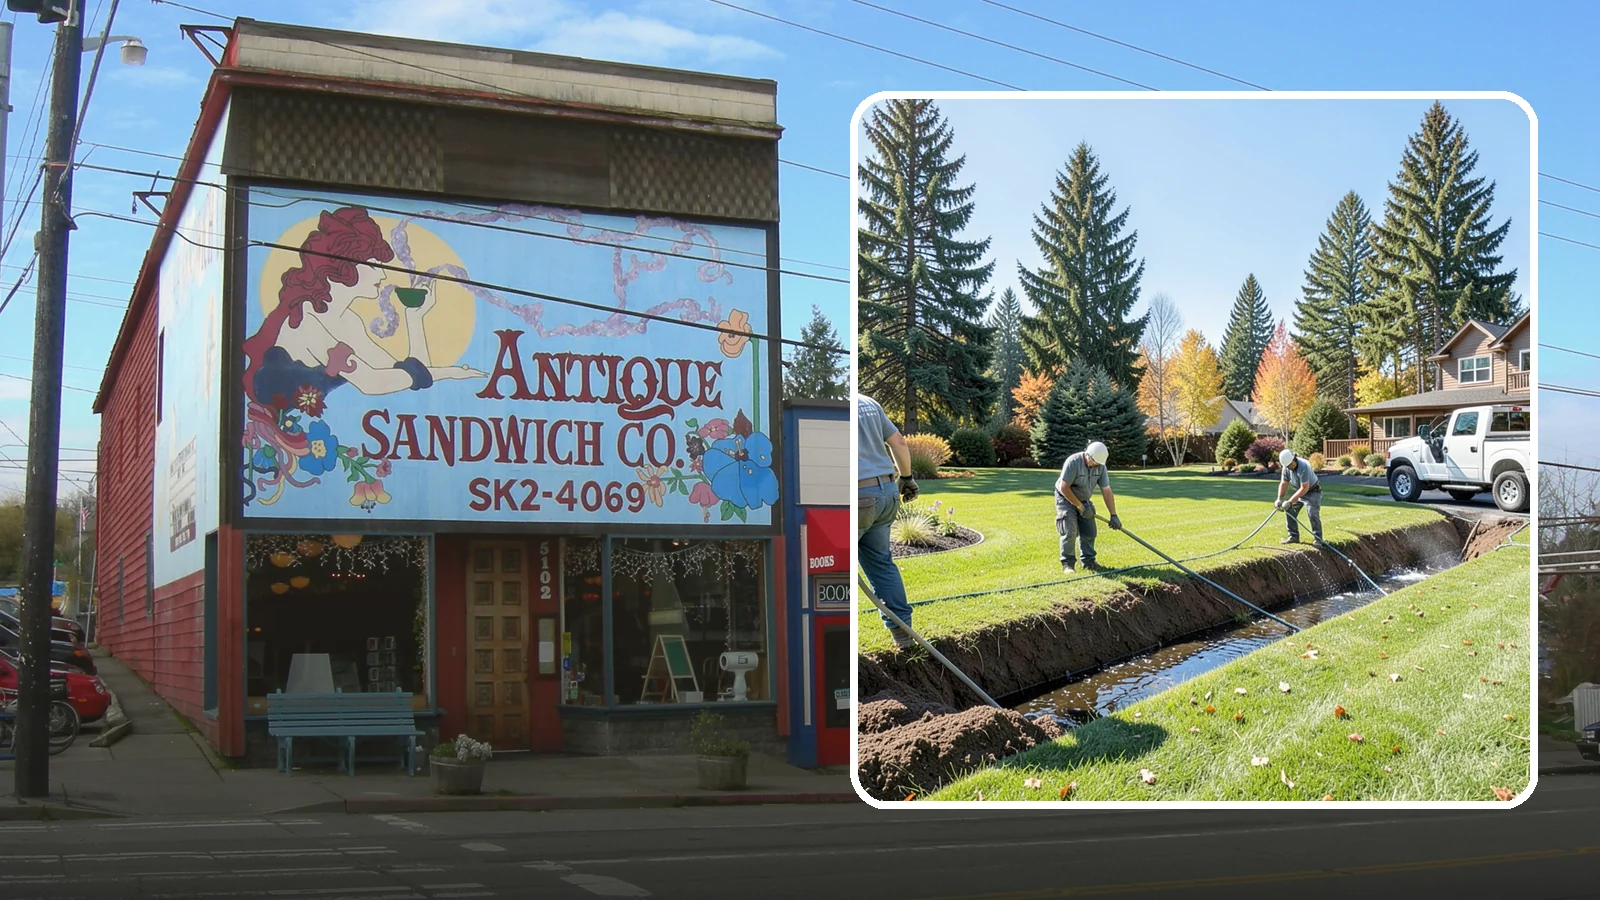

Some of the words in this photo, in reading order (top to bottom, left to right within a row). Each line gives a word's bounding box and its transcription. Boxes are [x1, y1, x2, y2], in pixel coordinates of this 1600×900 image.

[475, 329, 724, 421] ANTIQUE
[360, 408, 605, 468] SANDWICH
[616, 422, 685, 469] CO.
[468, 476, 646, 513] SK2-4069
[539, 541, 552, 600] 5102
[809, 555, 835, 569] BOOKS
